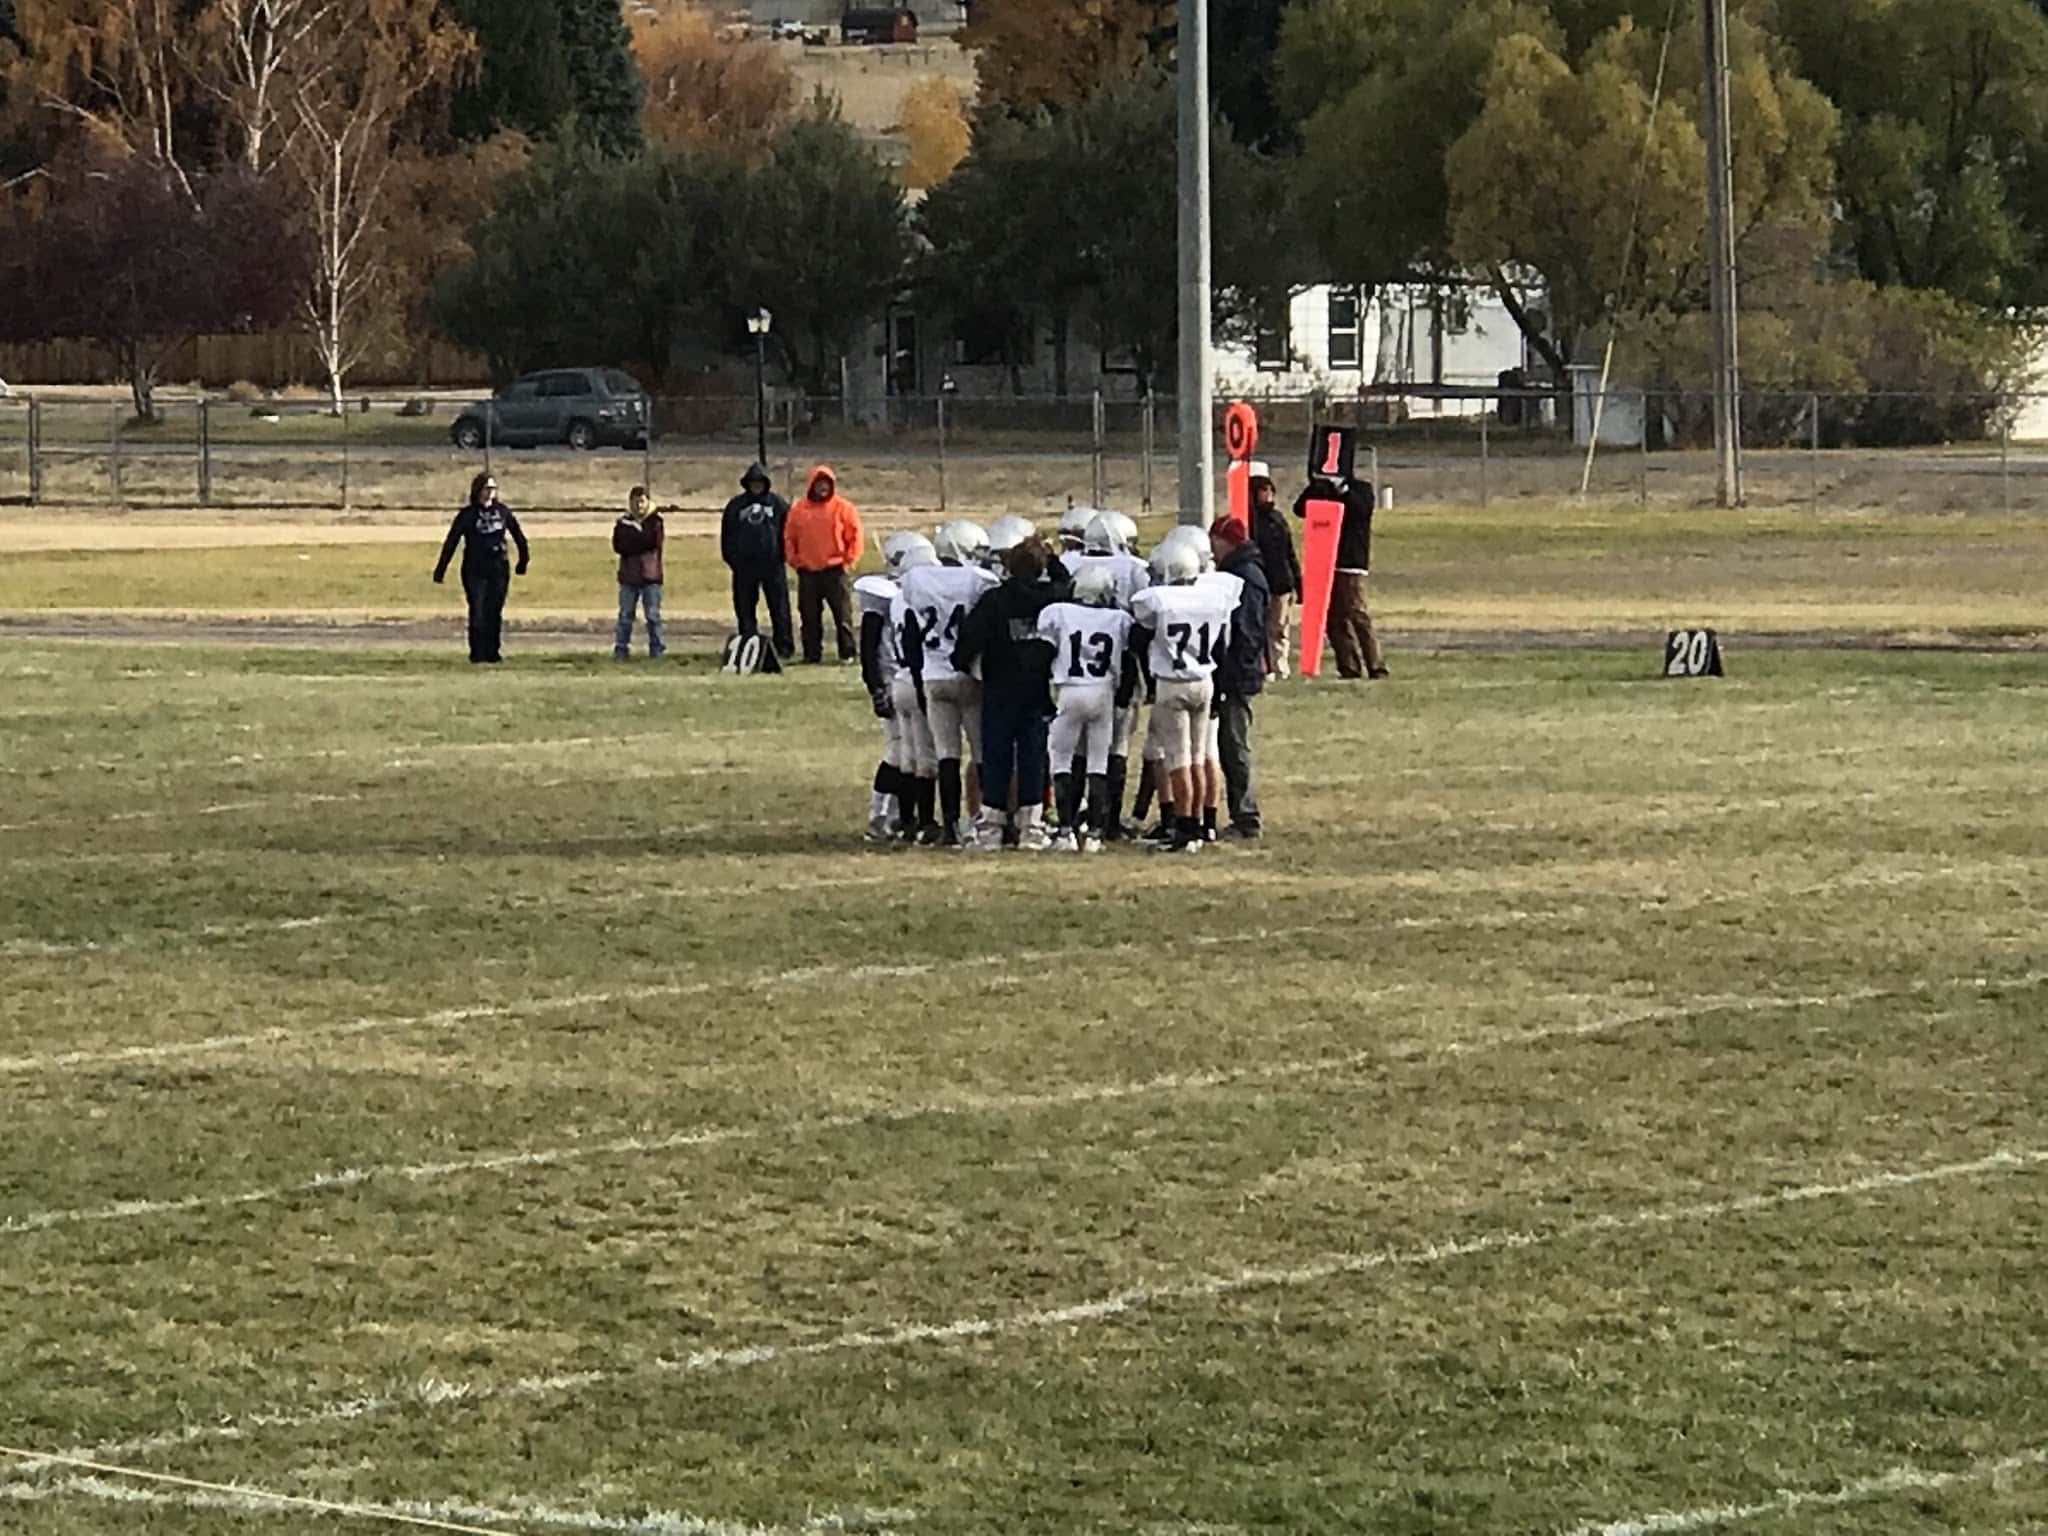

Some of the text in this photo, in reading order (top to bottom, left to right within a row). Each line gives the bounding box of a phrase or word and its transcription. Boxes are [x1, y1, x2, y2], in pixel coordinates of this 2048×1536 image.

[1229, 412, 1245, 450] 0
[1321, 432, 1341, 473] 1
[721, 634, 760, 673] 10
[1068, 629, 1113, 678] 13
[1167, 621, 1211, 670] 71
[1667, 631, 1708, 675] 20
